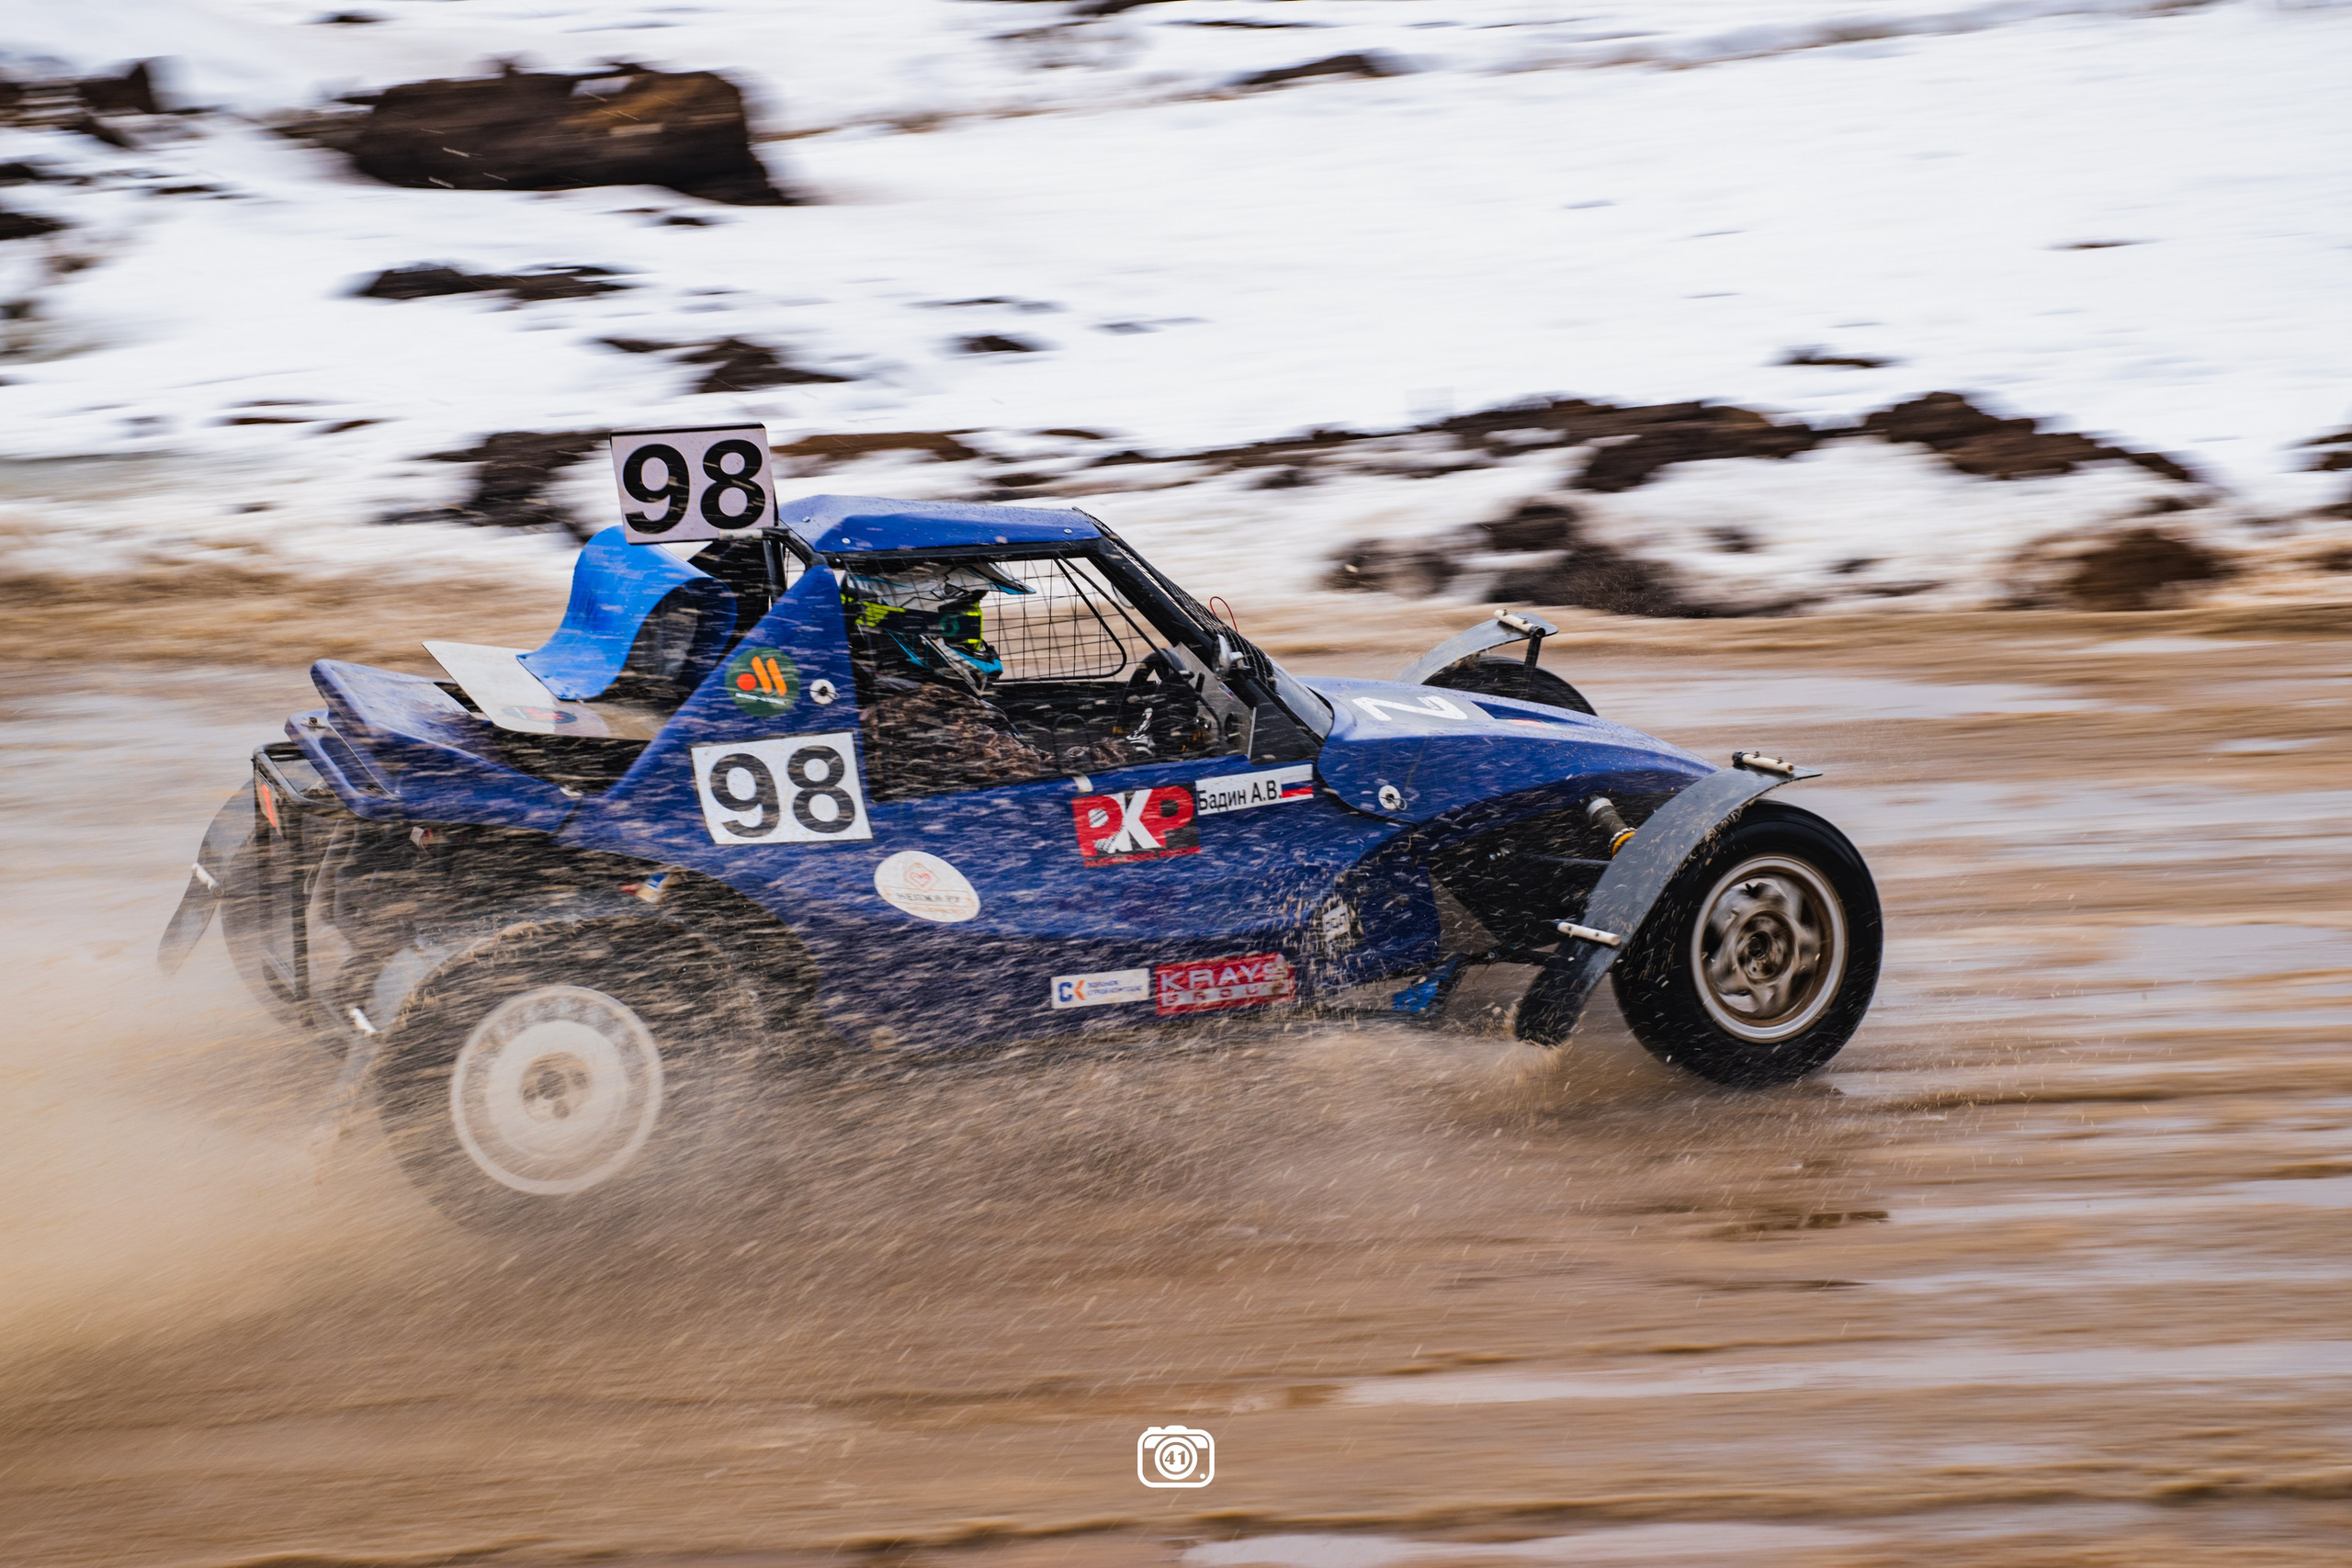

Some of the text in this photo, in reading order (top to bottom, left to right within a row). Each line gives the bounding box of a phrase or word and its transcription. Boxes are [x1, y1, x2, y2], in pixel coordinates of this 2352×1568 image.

[622, 439, 765, 534] 98
[709, 745, 856, 838] 98
[1196, 789, 1247, 812] Бадин
[1160, 962, 1289, 991] KRAYS
